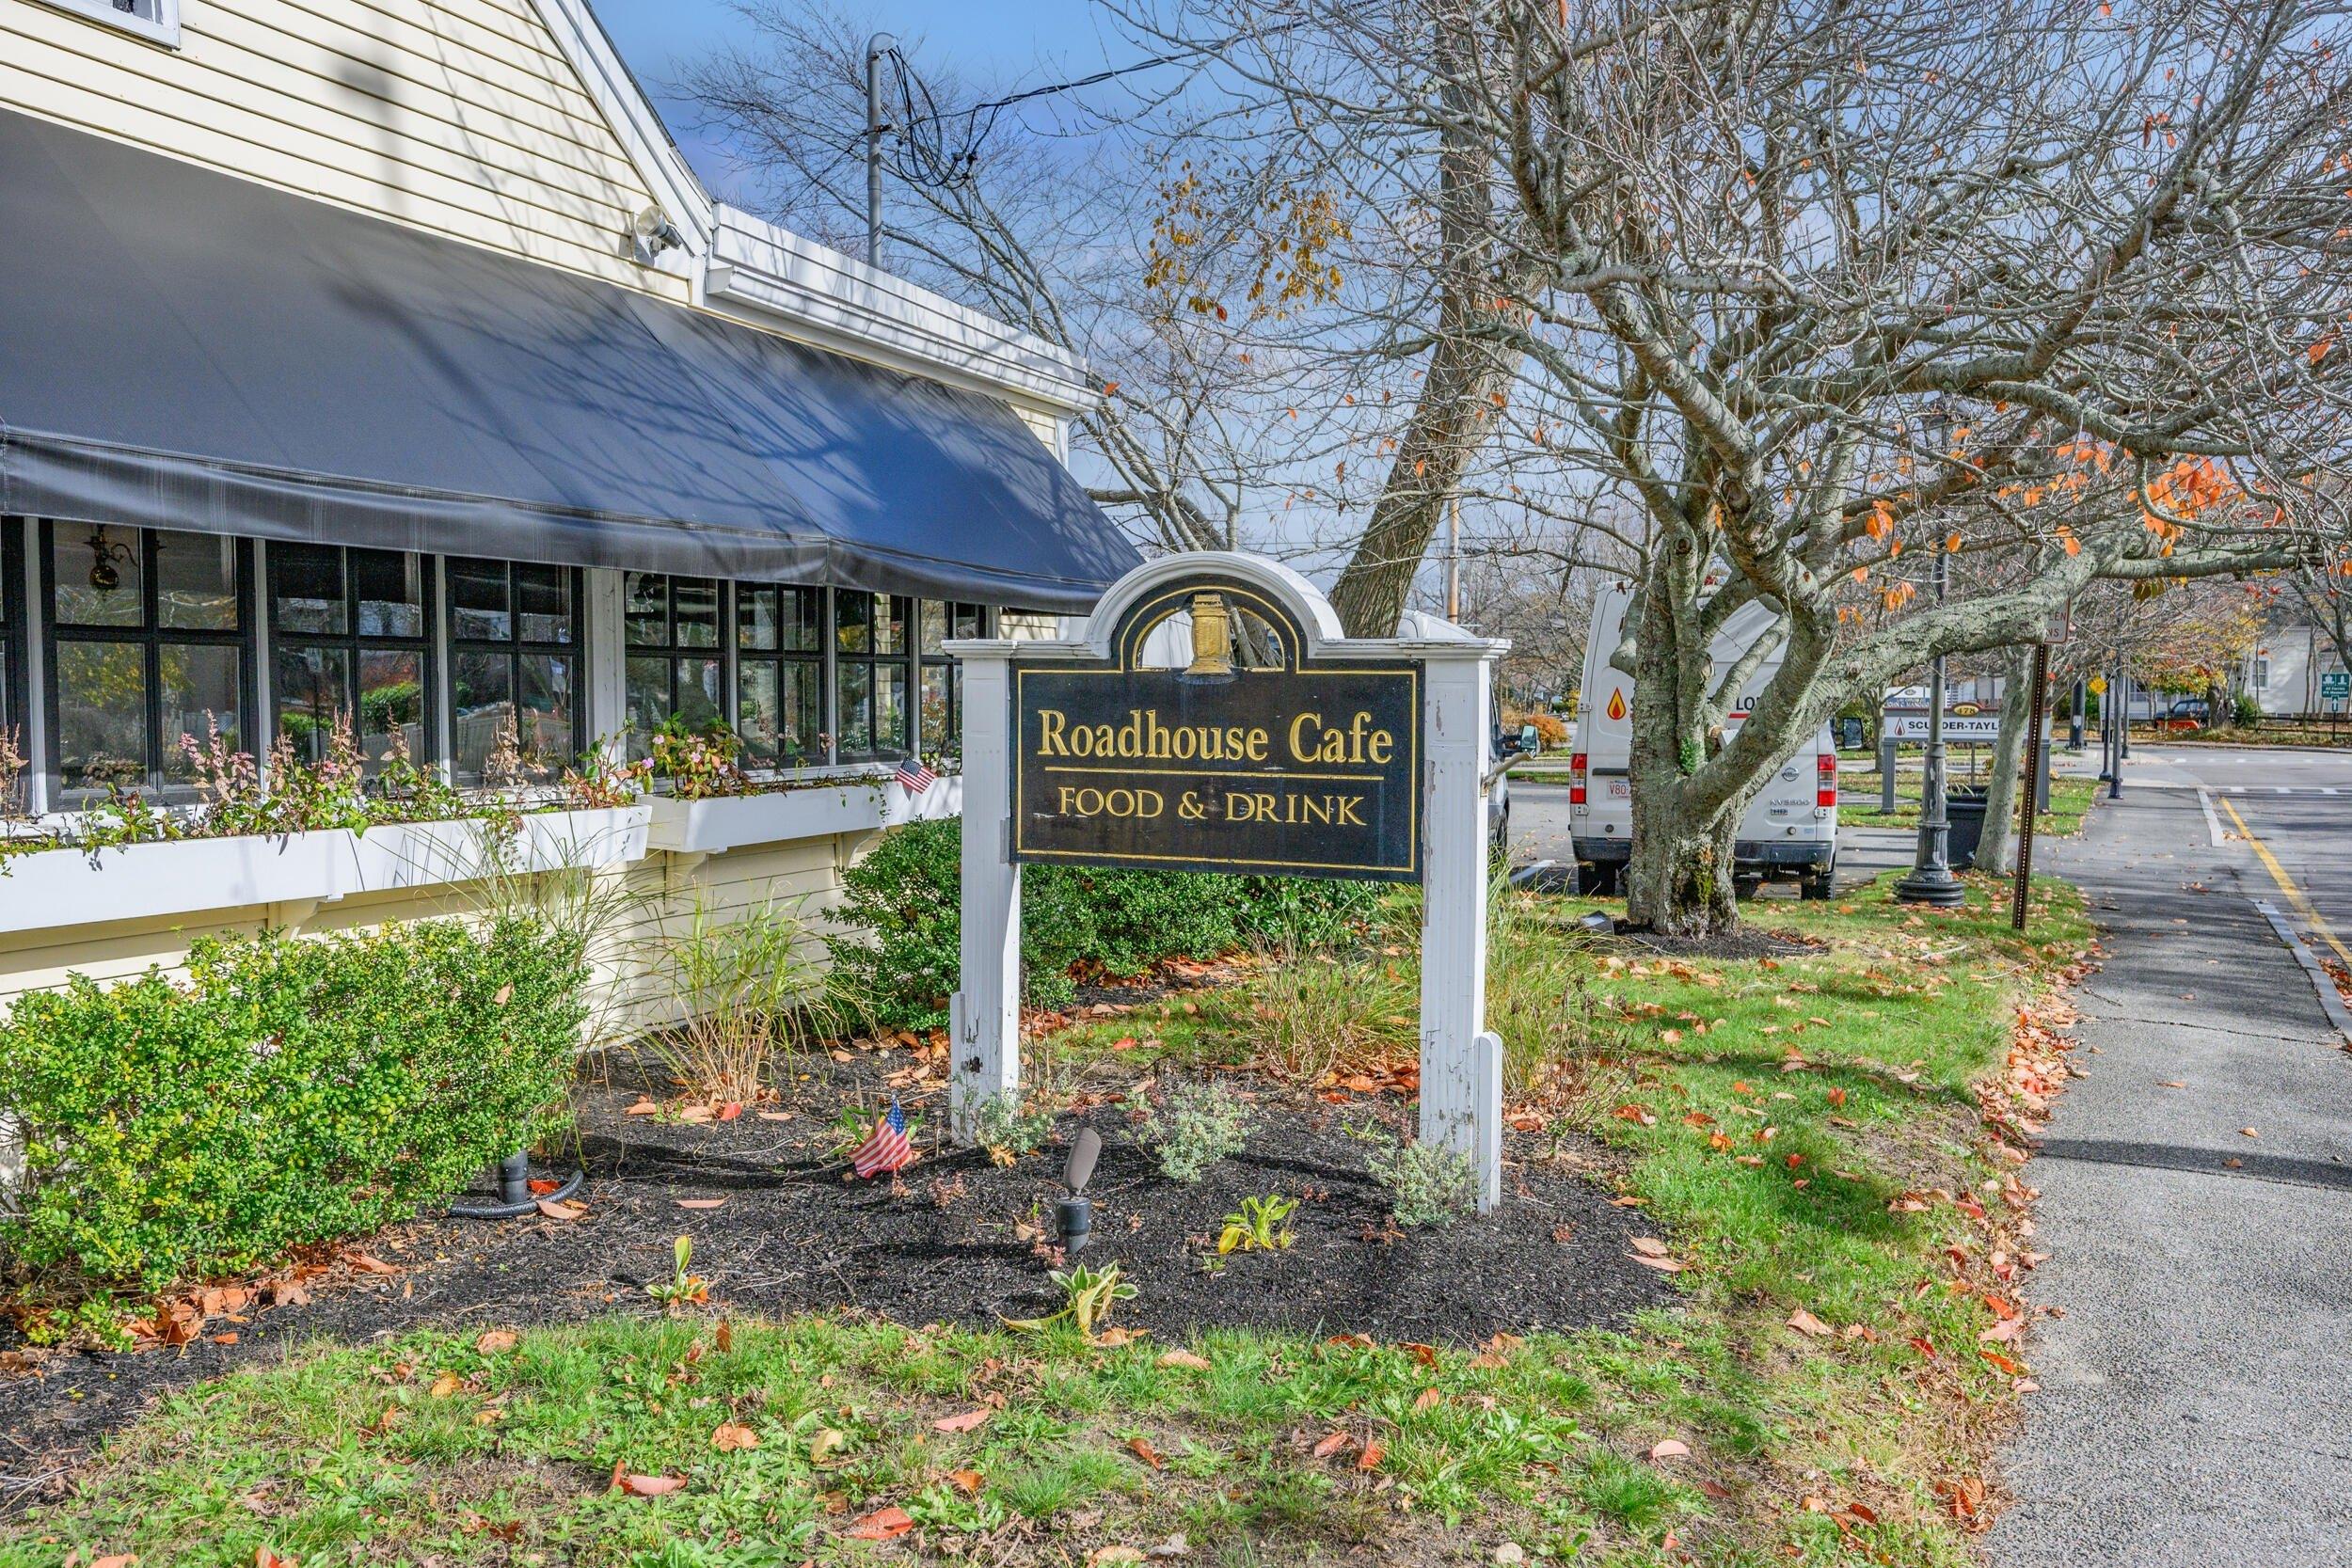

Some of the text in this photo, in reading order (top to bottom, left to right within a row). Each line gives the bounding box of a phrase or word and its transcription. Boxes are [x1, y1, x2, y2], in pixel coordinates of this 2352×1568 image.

[1037, 709, 1393, 764] Roadhouse Cafe
[1057, 786, 1367, 826] FOOD & DRINK
